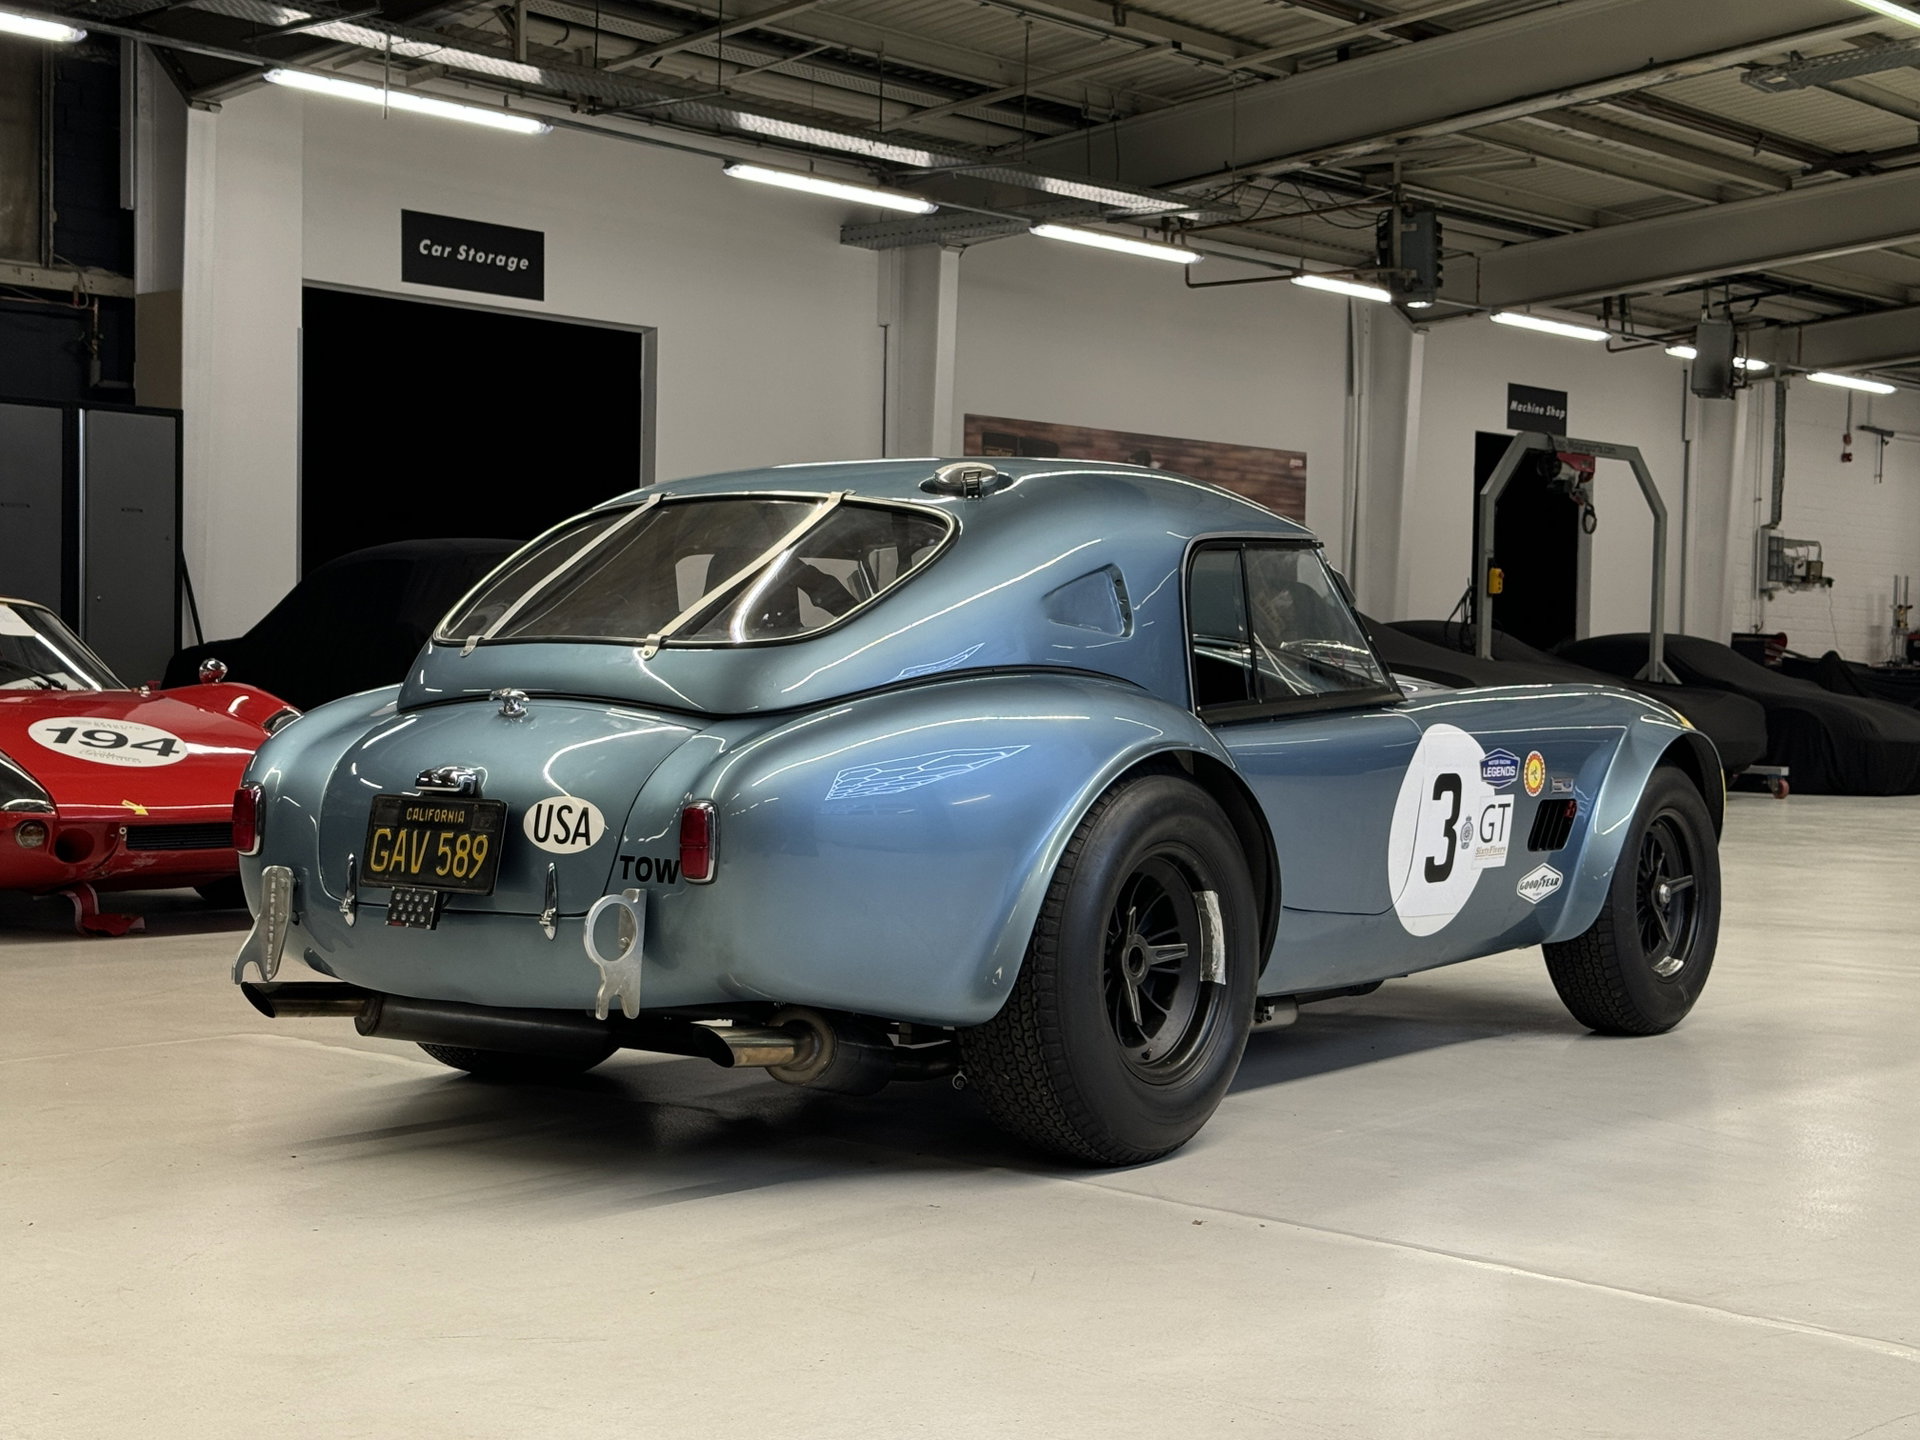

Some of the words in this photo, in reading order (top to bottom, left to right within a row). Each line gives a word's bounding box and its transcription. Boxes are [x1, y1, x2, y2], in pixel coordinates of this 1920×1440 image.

[419, 239, 452, 258] Car
[457, 245, 529, 272] Storage
[1510, 400, 1545, 415] Machine
[1546, 405, 1566, 420] Shop
[45, 726, 180, 757] 194
[1483, 766, 1516, 778] LEGENDS
[406, 807, 465, 823] CALIFORNIA
[533, 803, 591, 846] USA
[1424, 772, 1462, 883] 3
[1479, 803, 1511, 843] GT
[370, 828, 431, 874] GAV
[435, 832, 489, 879] 589
[619, 855, 681, 884] TOW
